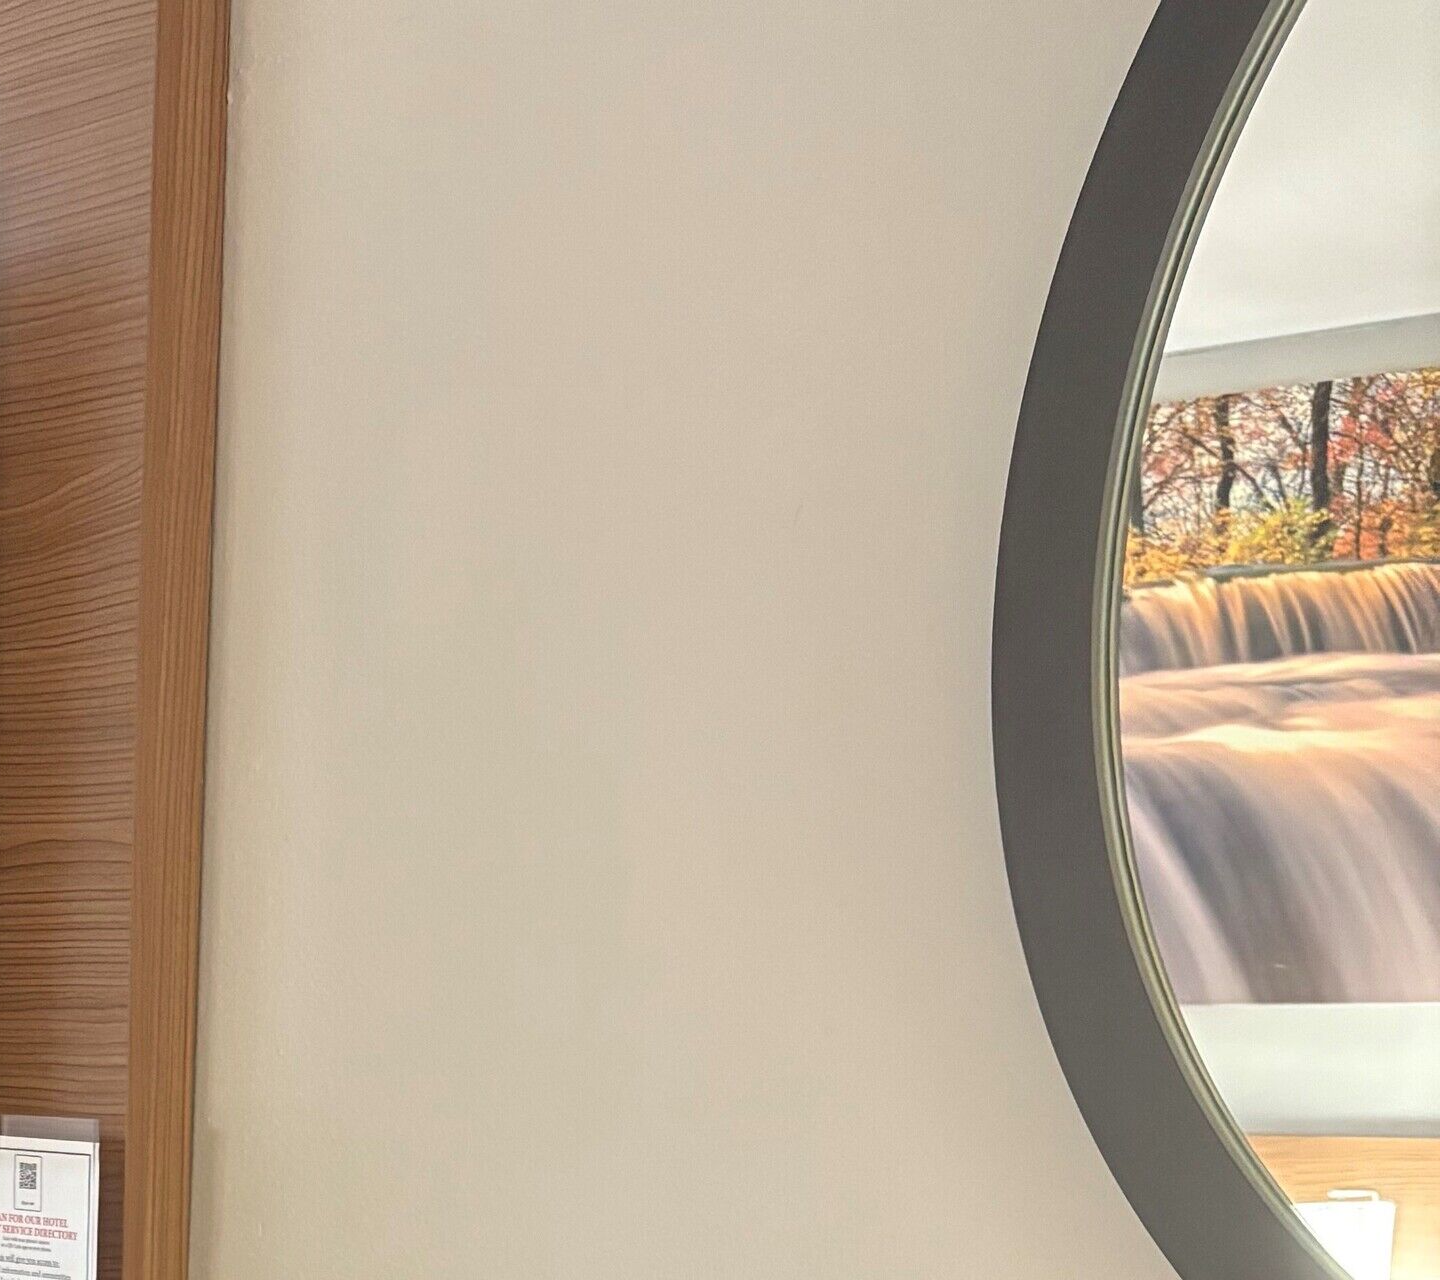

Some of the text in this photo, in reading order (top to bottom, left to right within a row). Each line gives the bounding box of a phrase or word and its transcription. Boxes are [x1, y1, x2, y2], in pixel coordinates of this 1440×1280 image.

[8, 1213, 24, 1224] FOR
[24, 1215, 41, 1226] OUR
[42, 1217, 69, 1229] HOTEL
[2, 1224, 33, 1237] SERVICE
[34, 1227, 78, 1241] DIRECTORY
